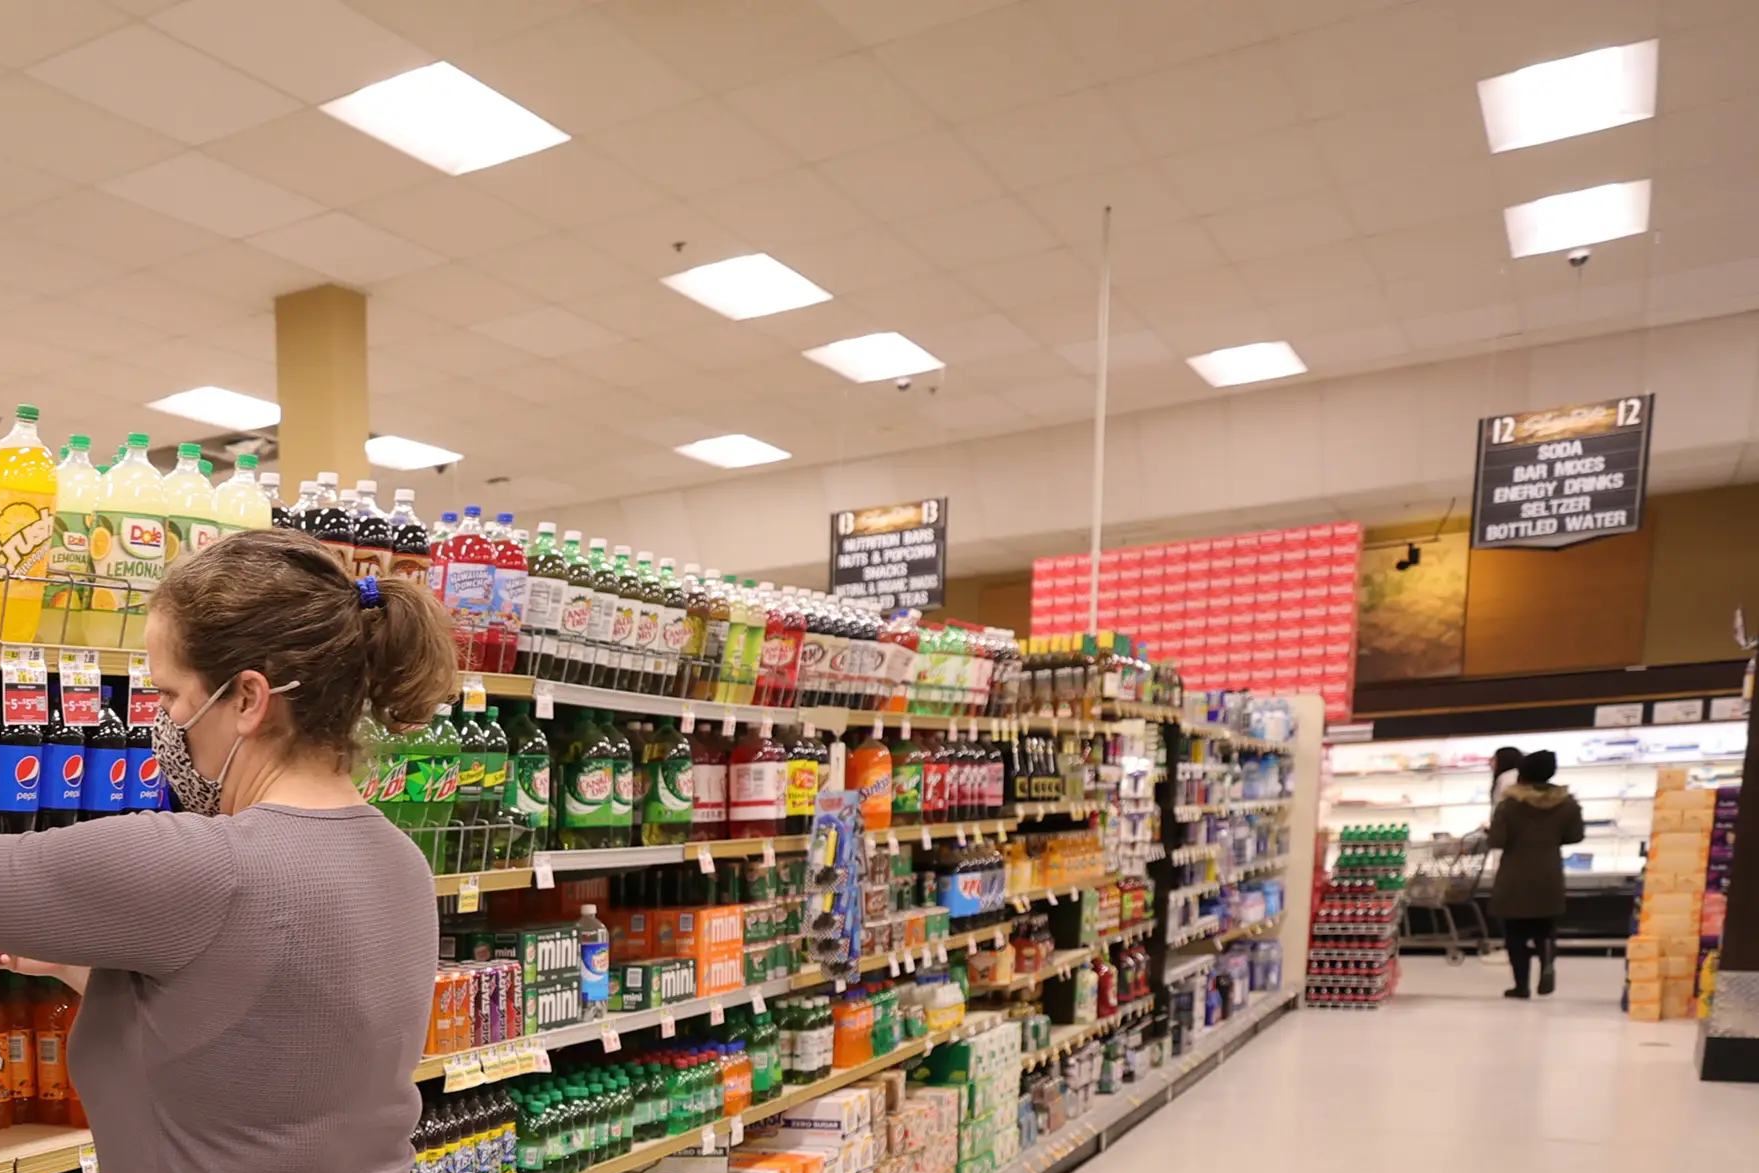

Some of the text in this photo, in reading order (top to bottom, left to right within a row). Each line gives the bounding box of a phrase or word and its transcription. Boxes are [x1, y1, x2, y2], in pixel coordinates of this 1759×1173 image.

[1617, 398, 1641, 426] 12
[1492, 417, 1515, 444] 12
[1538, 440, 1582, 460] SODA
[1513, 456, 1605, 482] BAR MIXES
[1493, 473, 1624, 503] ENERGY DRINKS
[1520, 497, 1590, 518] SELTZER
[130, 525, 162, 546] Dole
[1486, 510, 1627, 541] BOTTLED WATER
[843, 528, 934, 552] NUTRITION BARS
[838, 552, 868, 569] NUTS
[882, 543, 936, 563] POPCORN
[863, 562, 908, 581] SNACKS
[711, 909, 740, 942] mini
[538, 930, 577, 971] mini
[661, 960, 695, 997] mini
[711, 955, 740, 985] mini
[539, 981, 578, 1024] mini
[792, 1120, 838, 1129] ZERO SUGAR
